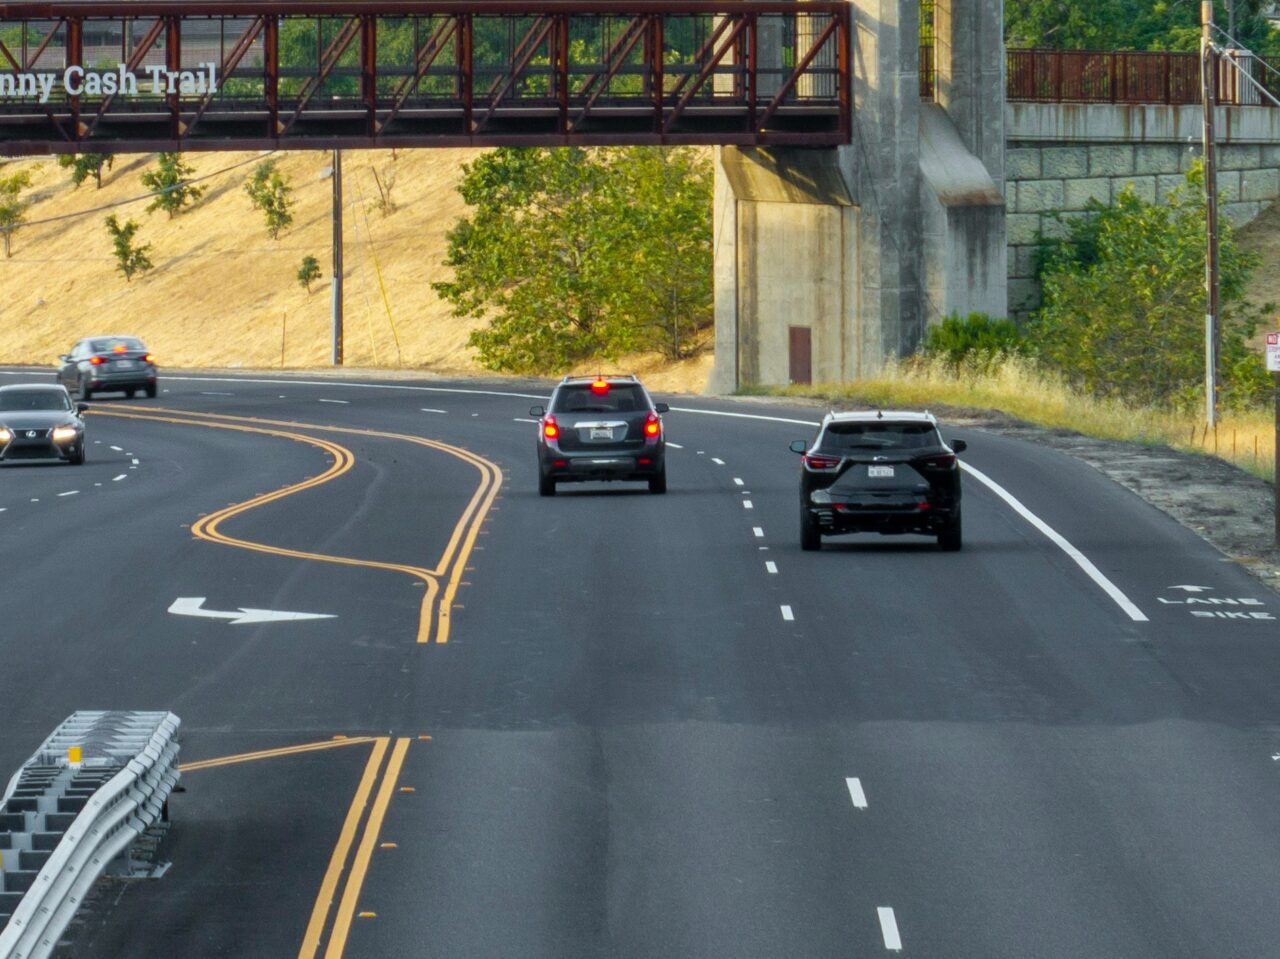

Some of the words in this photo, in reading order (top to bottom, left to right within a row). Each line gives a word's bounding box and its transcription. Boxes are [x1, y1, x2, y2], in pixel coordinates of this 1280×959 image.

[63, 64, 138, 95] Cash
[145, 62, 218, 95] Trail
[1156, 597, 1265, 605] LANE
[1189, 610, 1277, 620] BIKE
